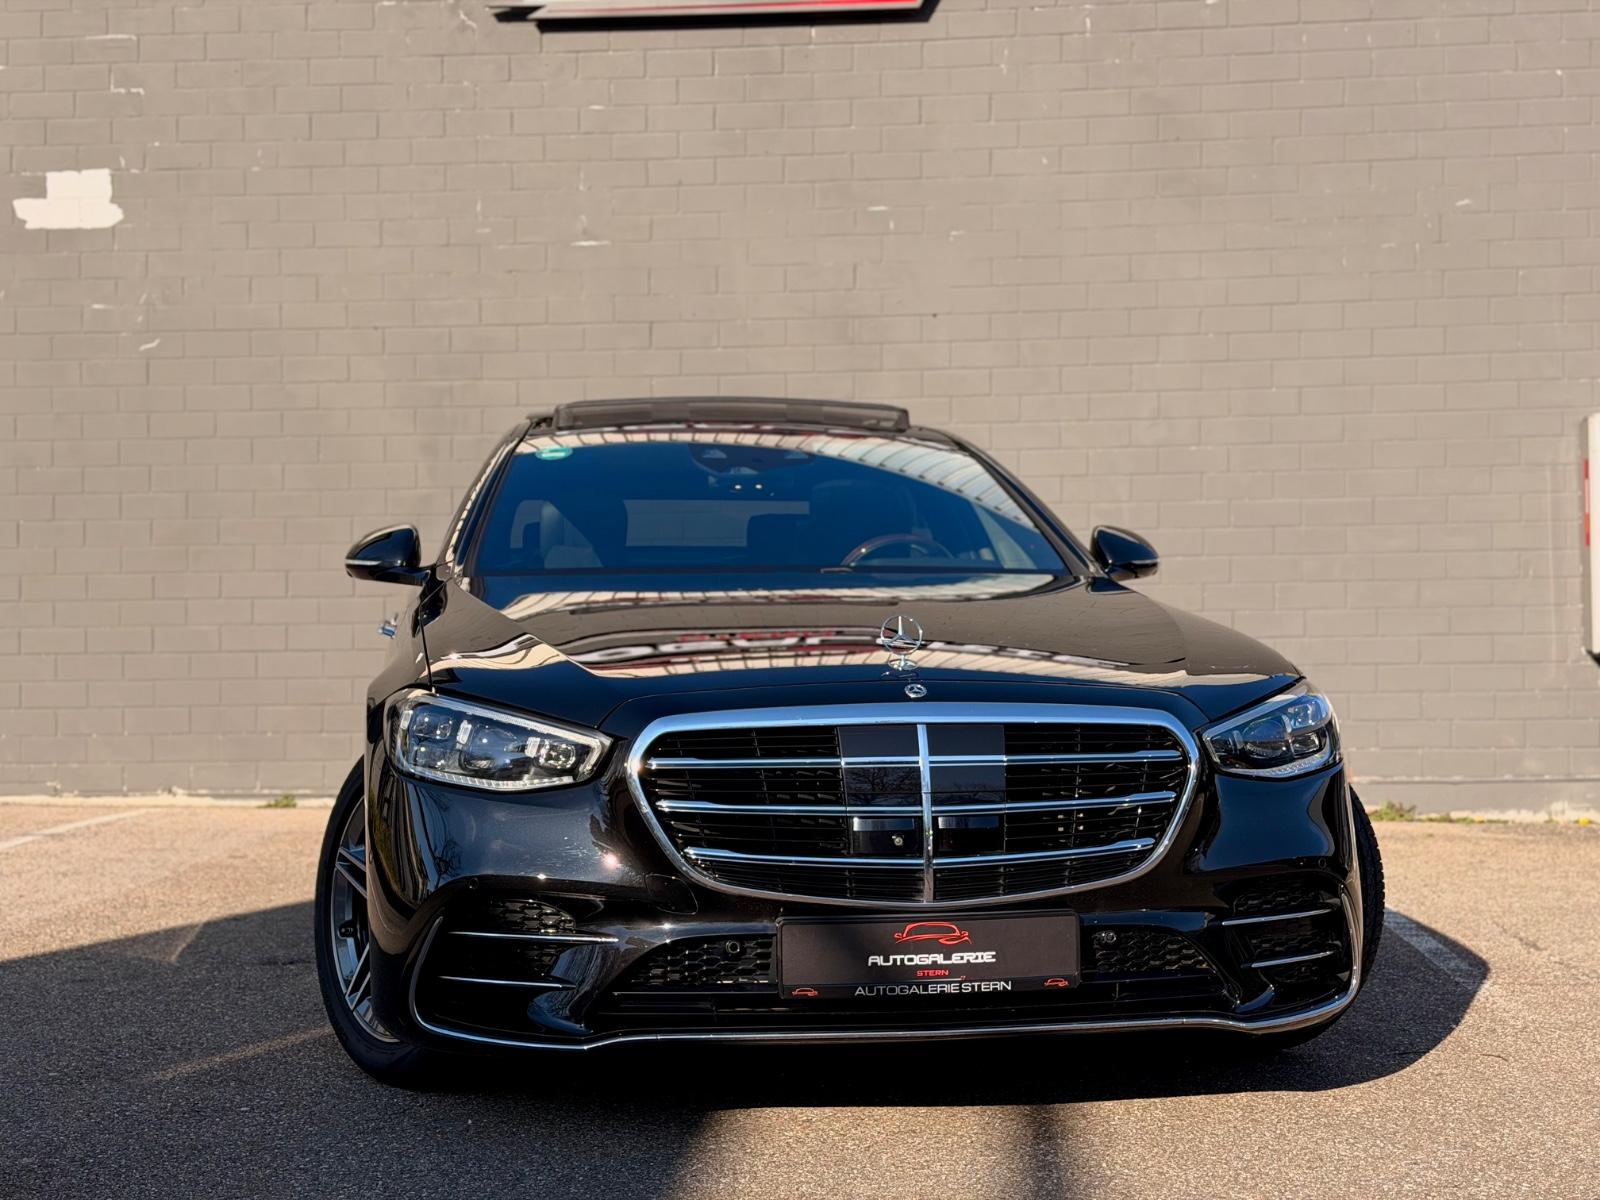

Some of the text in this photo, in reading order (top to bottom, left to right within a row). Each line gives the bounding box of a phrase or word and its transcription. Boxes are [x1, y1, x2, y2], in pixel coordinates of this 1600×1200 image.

[867, 951, 996, 967] AUTOGALERIE
[916, 969, 949, 977] STERN
[961, 980, 1012, 993] STERN
